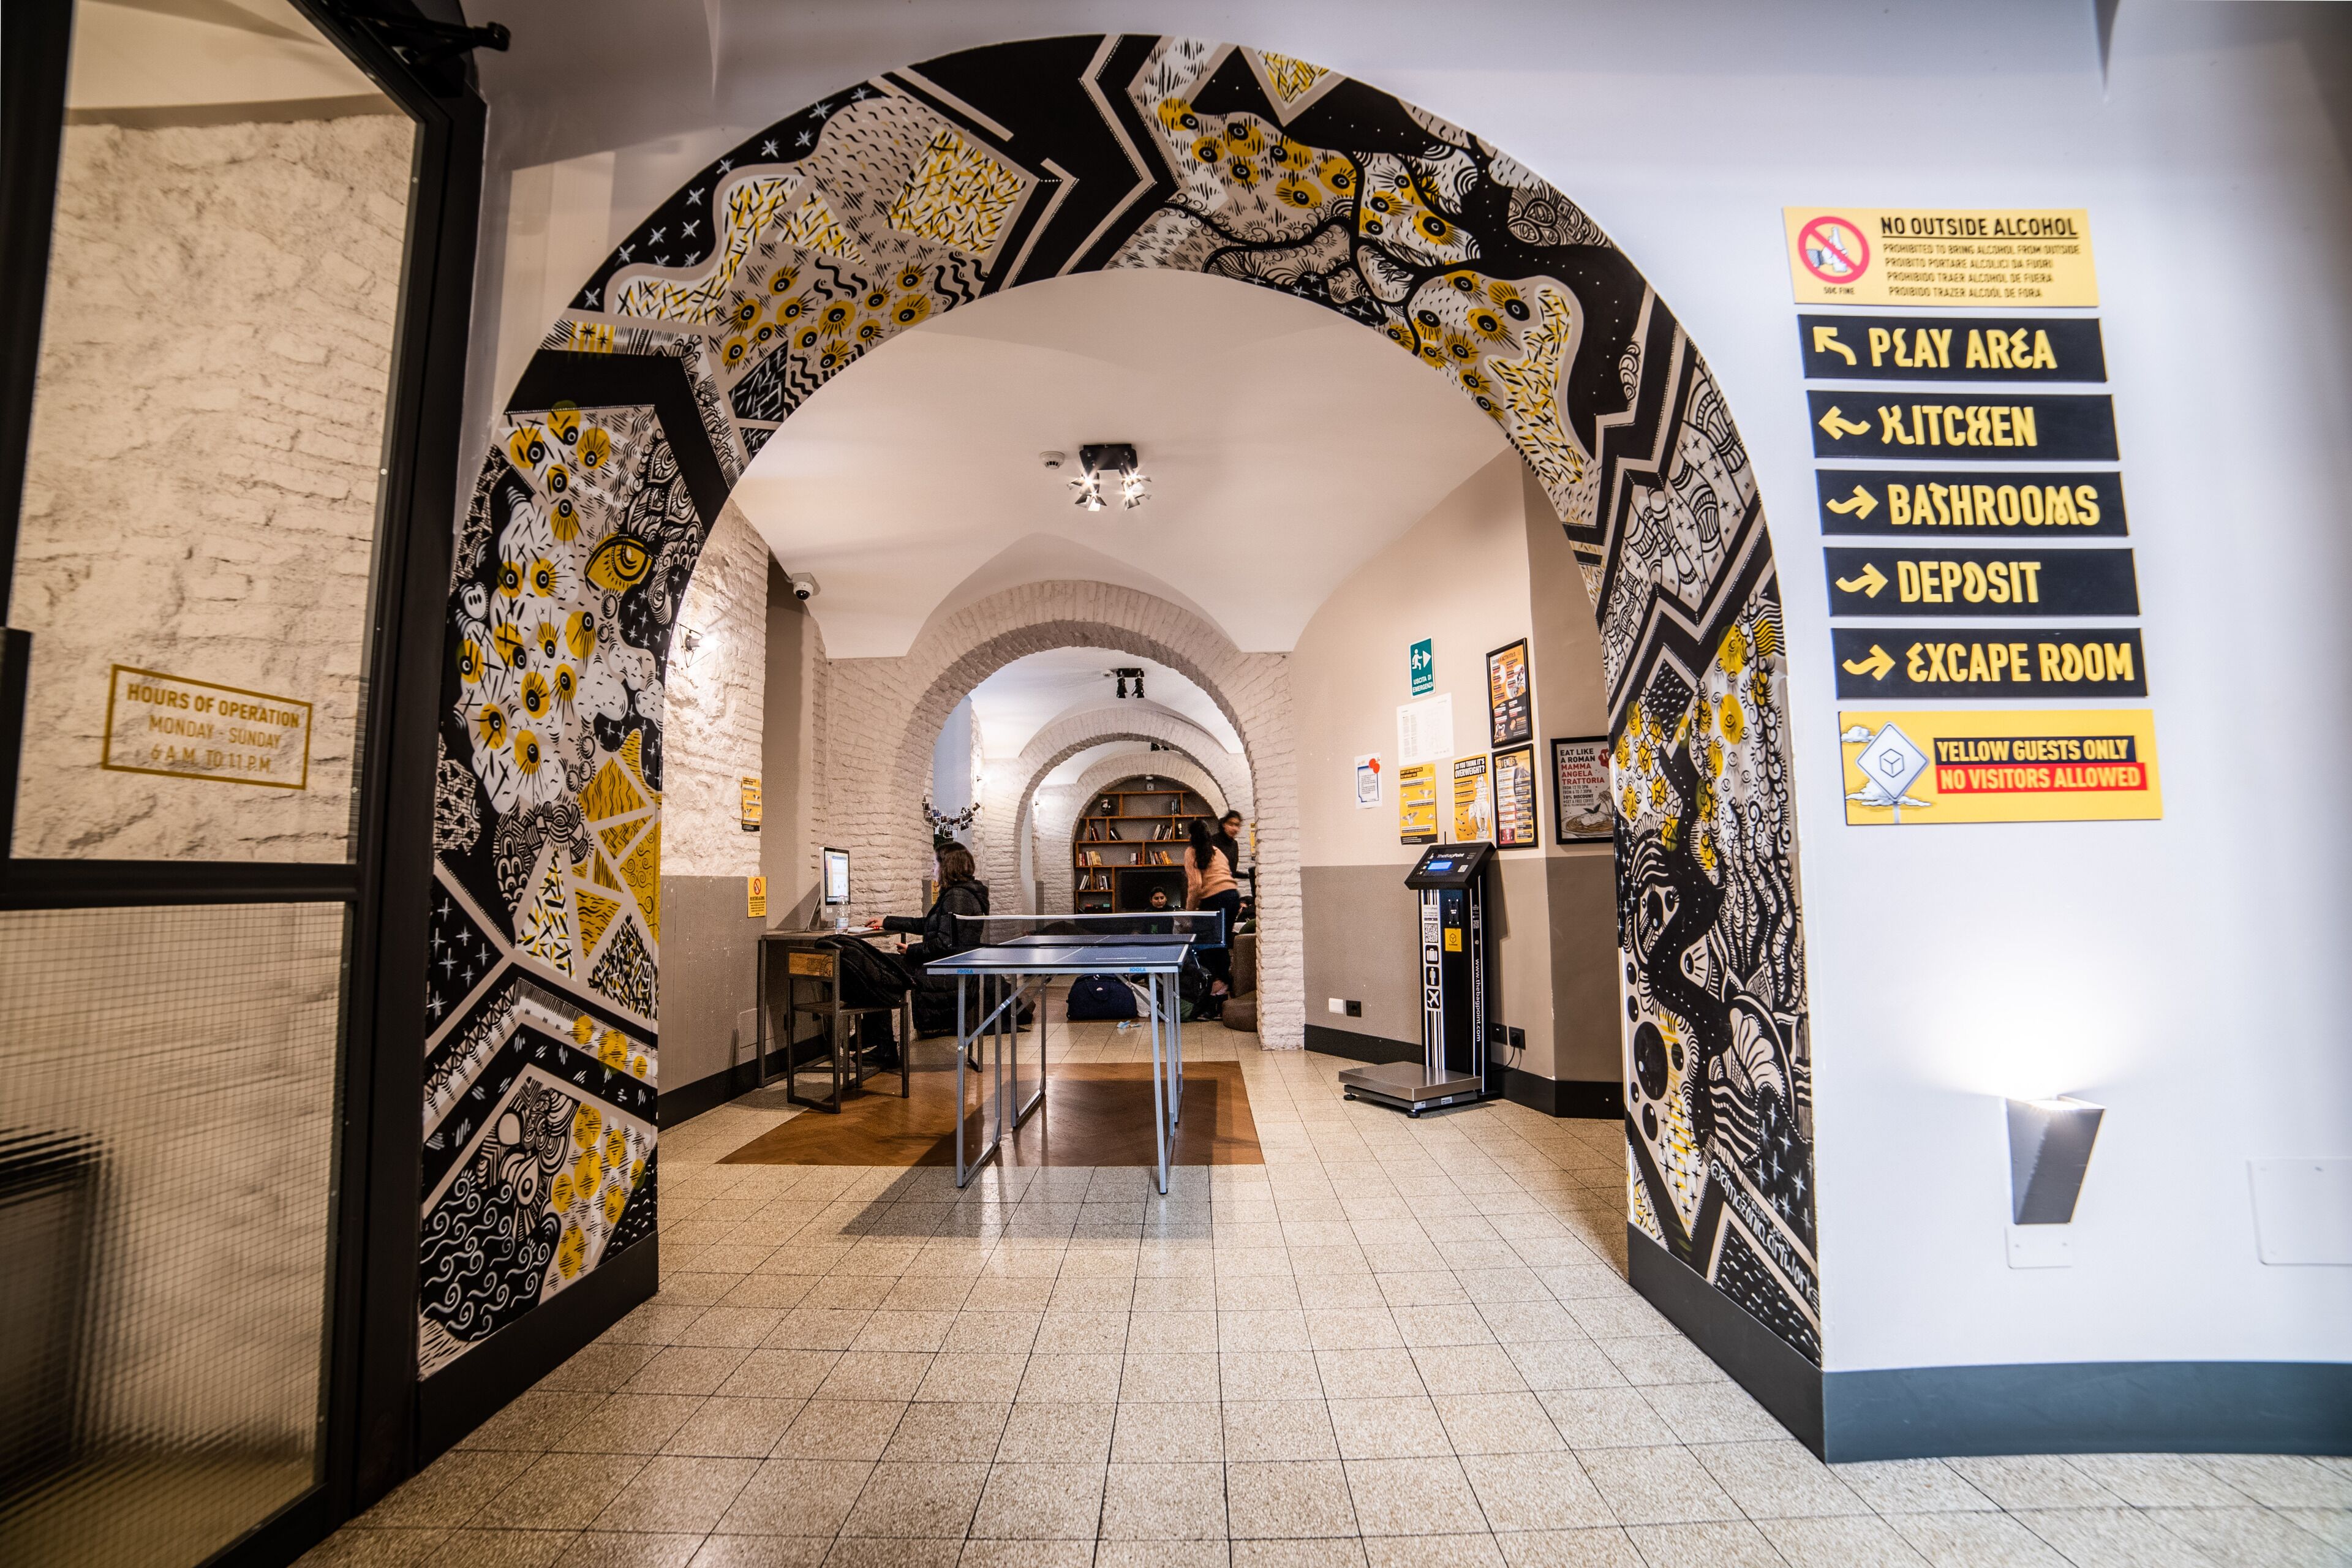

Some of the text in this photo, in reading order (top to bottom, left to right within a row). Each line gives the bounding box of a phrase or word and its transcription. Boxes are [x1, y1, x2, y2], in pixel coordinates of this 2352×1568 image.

[1881, 217, 2078, 236] NO OUTSIDE ALCOHOL
[1883, 244, 2080, 255] PROHIBITED TO BRING ALCOHOL FROM OUTSIDE
[1885, 258, 1926, 268] PROIBITO
[1929, 258, 1967, 268] PORTARE
[2011, 259, 2023, 268] DA
[2026, 259, 2052, 268] FUORI
[1887, 272, 2052, 282] PROHIBIDO TRAER ALCOHOL DE FUERA
[1889, 286, 1931, 296] PROIBIDO
[1934, 287, 1966, 297] TRAZER
[2004, 288, 2015, 298] DE
[2018, 288, 2042, 298] FORA
[1869, 328, 2057, 369] PLAY AREA
[1878, 405, 2037, 446] KITCHEN
[1887, 482, 2100, 526] BATHROOMS
[1897, 561, 2041, 603] DEPOSIT
[1906, 643, 2135, 682] EXCAPE ROOM
[1412, 682, 1433, 693] EMERGENZA
[1413, 676, 1427, 685] USCITA
[127, 683, 300, 728] HOURS OF OPERATION
[149, 714, 214, 739] MONDAY
[229, 728, 281, 749] SUNDAY
[152, 744, 162, 760] 6
[206, 749, 223, 767] TO
[229, 752, 241, 769] 11
[1937, 739, 2128, 761] YELLOW GUESTS ONLY
[1455, 765, 1485, 778] OVERWEIGHT?
[1940, 767, 2141, 790] NO VISITORS ALLOWED
